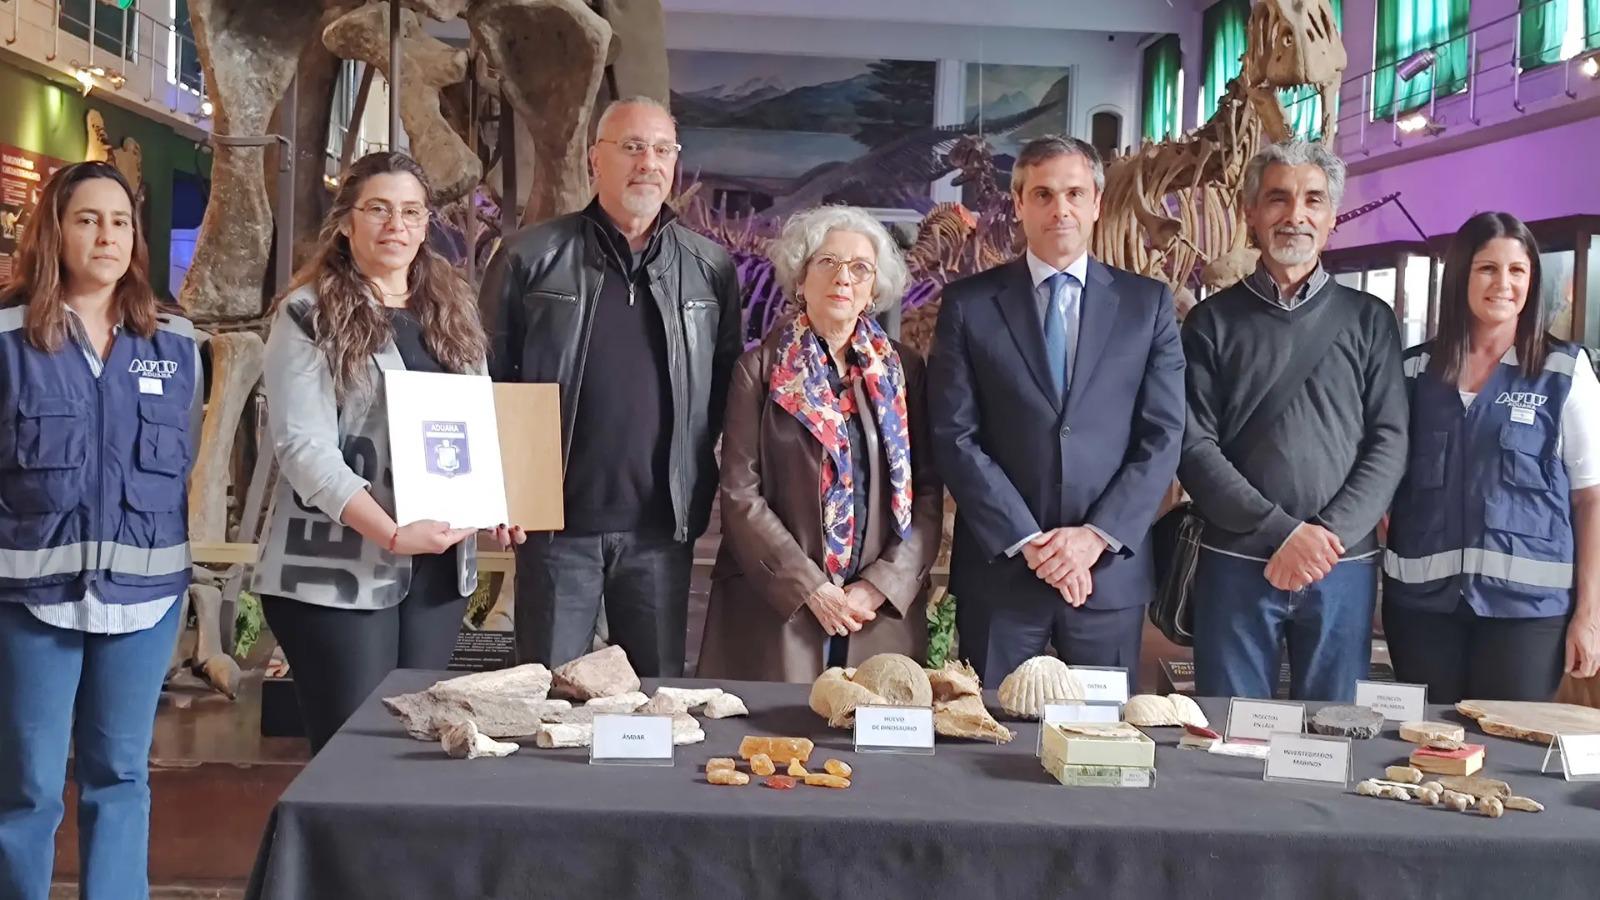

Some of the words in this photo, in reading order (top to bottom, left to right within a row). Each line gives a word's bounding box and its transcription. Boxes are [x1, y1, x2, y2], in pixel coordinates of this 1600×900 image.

[431, 423, 459, 433] ADUANA
[622, 732, 645, 740] ÁMBAR
[1283, 749, 1333, 759] INVERTEBRADOS
[1293, 759, 1322, 768] MARINOS
